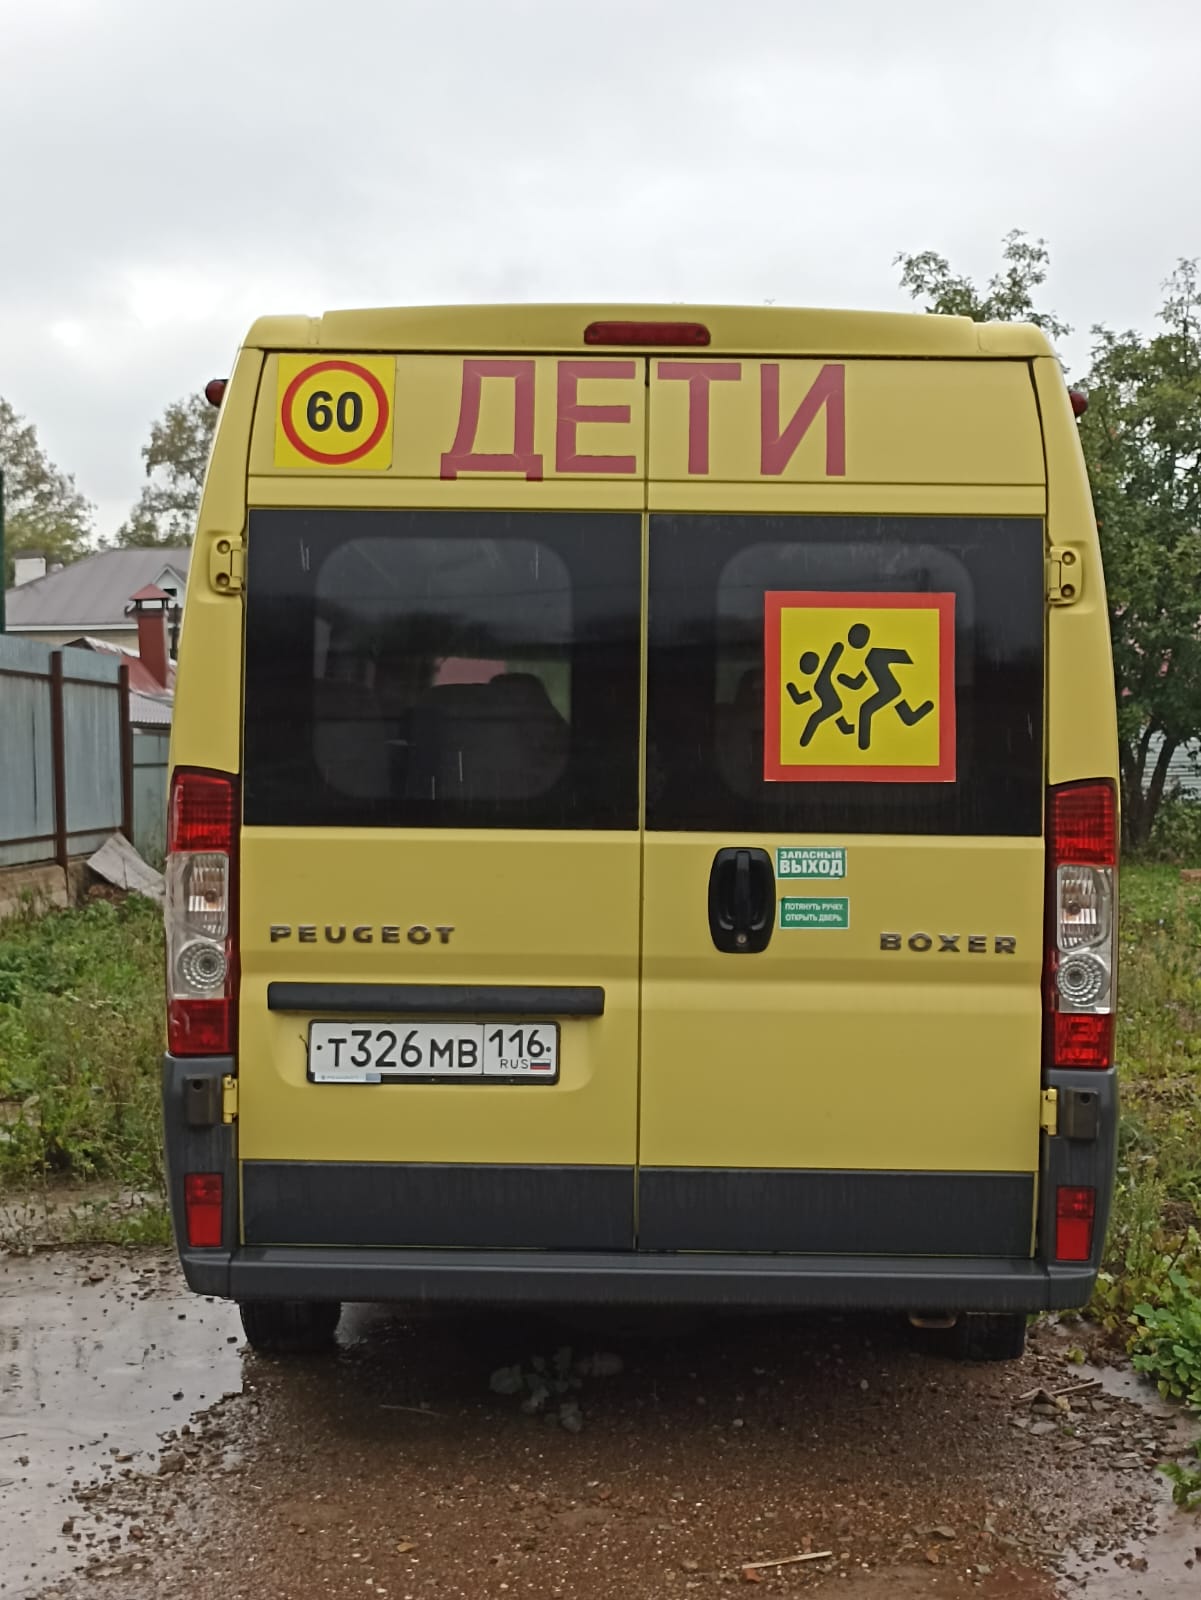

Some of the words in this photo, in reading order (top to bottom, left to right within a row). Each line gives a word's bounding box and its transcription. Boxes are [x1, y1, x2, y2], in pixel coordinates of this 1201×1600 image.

[306, 390, 363, 432] 60
[440, 359, 845, 481] ДЕТИ
[780, 850, 842, 859] ЗАПАСНЫЙ
[779, 859, 844, 876] ВЫХОД
[270, 924, 455, 944] PEUGEOT
[880, 932, 1017, 954] BOXER
[488, 1029, 545, 1058] 116
[500, 1058, 529, 1070] RUS
